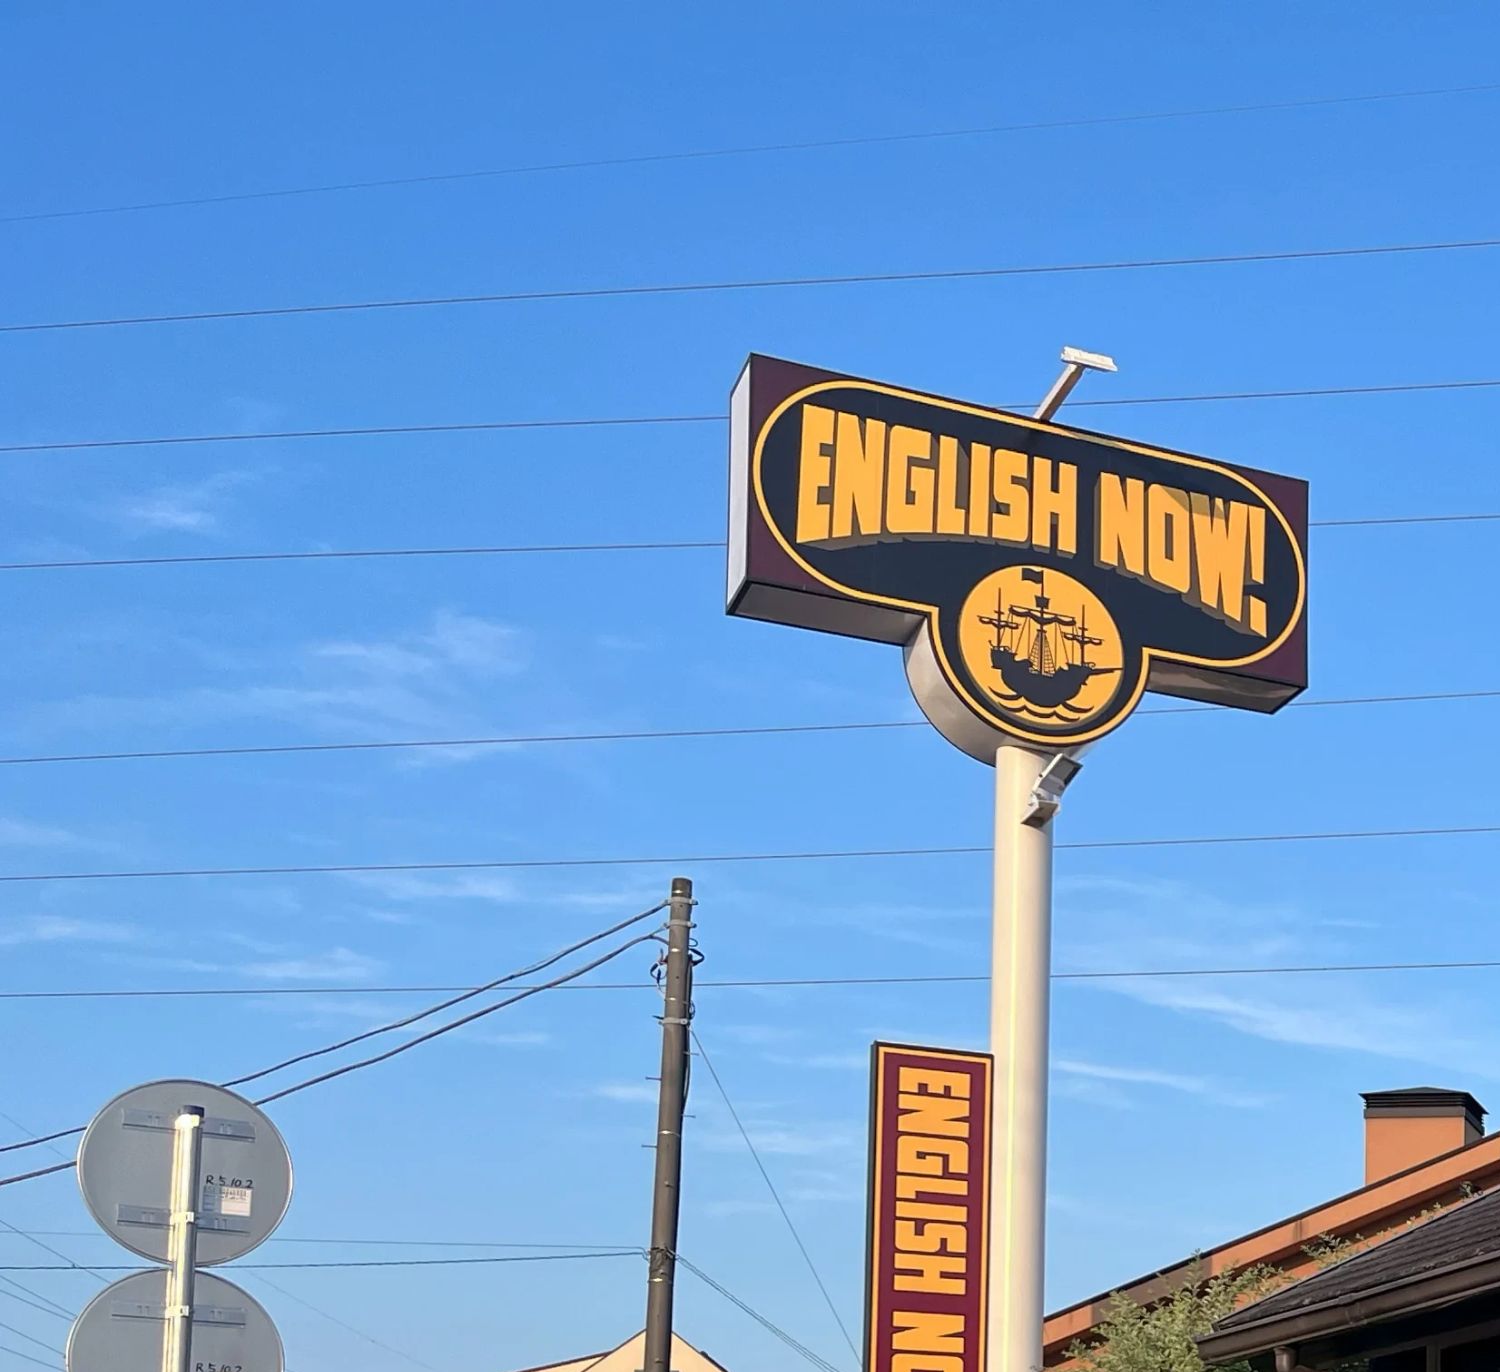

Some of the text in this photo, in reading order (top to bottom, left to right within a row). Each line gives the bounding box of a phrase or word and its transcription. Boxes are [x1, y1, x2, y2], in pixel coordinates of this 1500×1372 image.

[795, 403, 1268, 639] ENGLISH NOW!
[893, 1065, 971, 1296] ENGLISH
